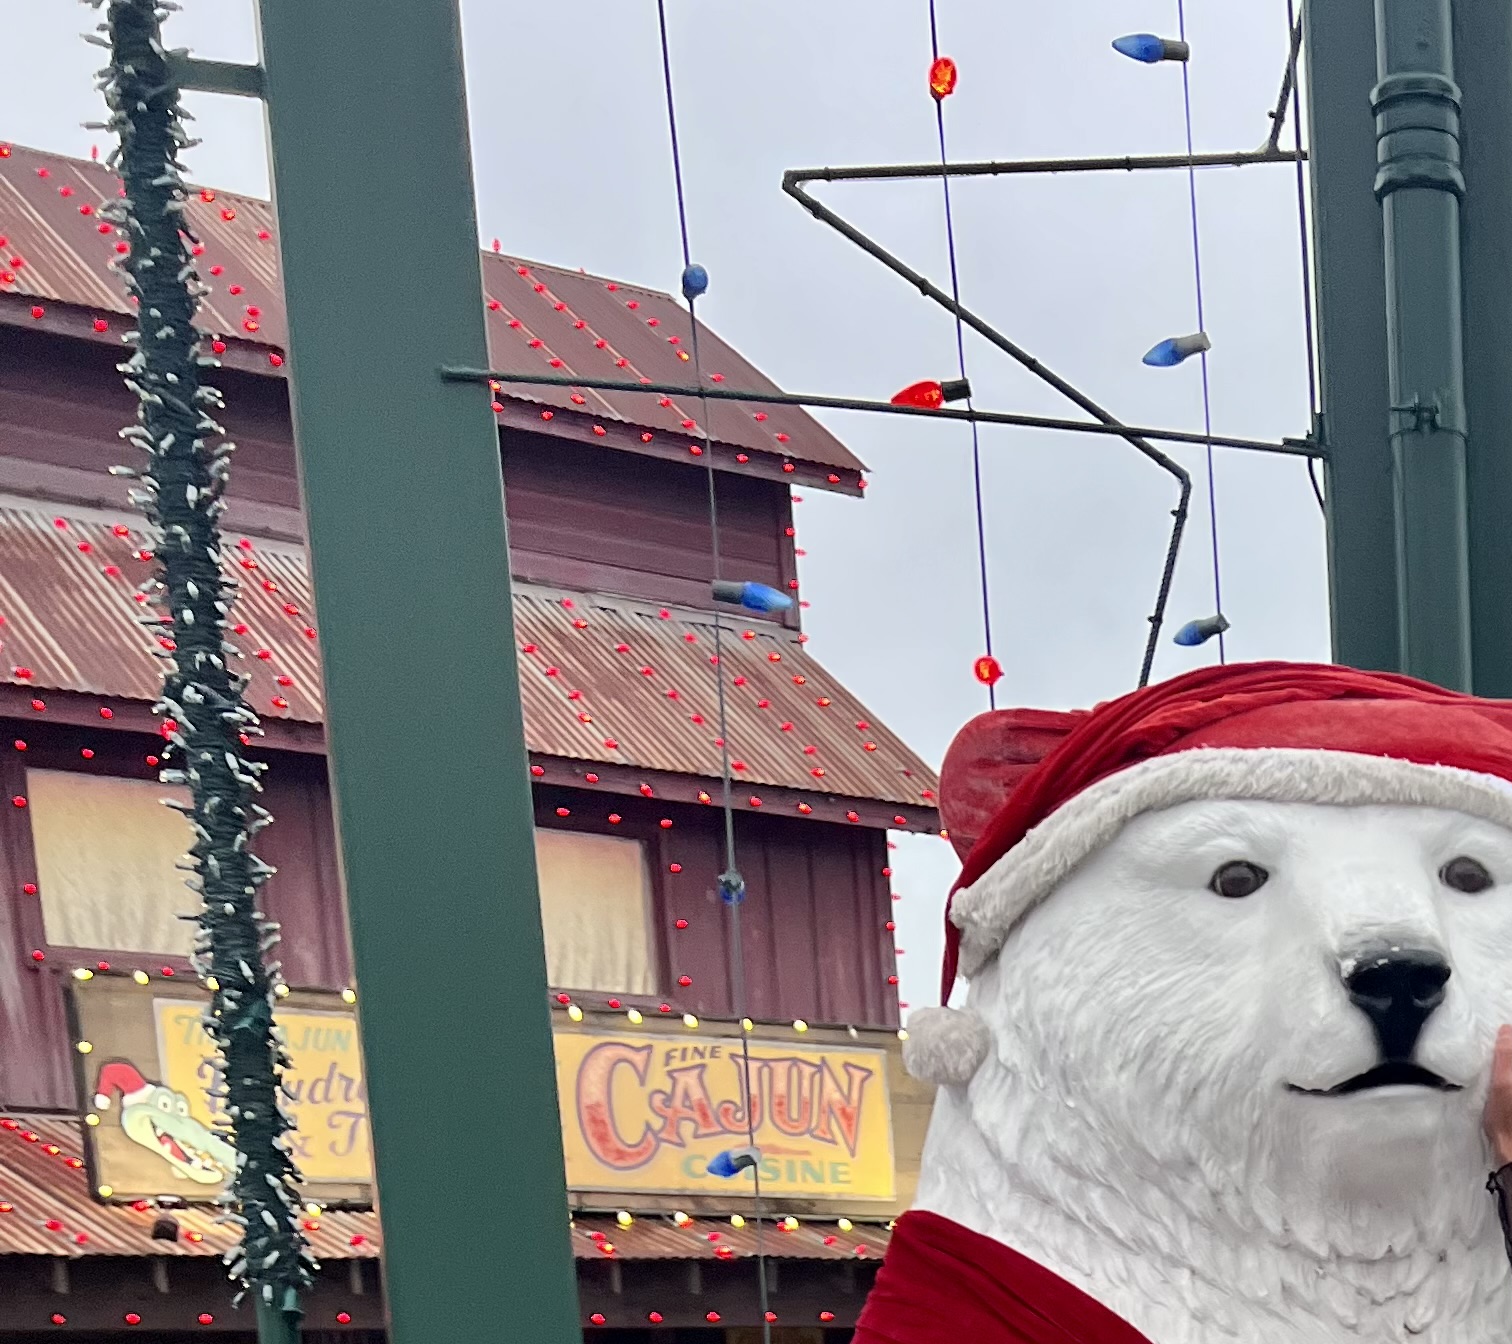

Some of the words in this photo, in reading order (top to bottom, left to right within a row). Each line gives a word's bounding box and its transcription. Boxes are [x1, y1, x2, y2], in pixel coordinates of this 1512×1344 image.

[664, 1045, 722, 1067] FINE
[576, 1041, 873, 1171] CAJUN
[681, 1153, 852, 1184] CSINE
